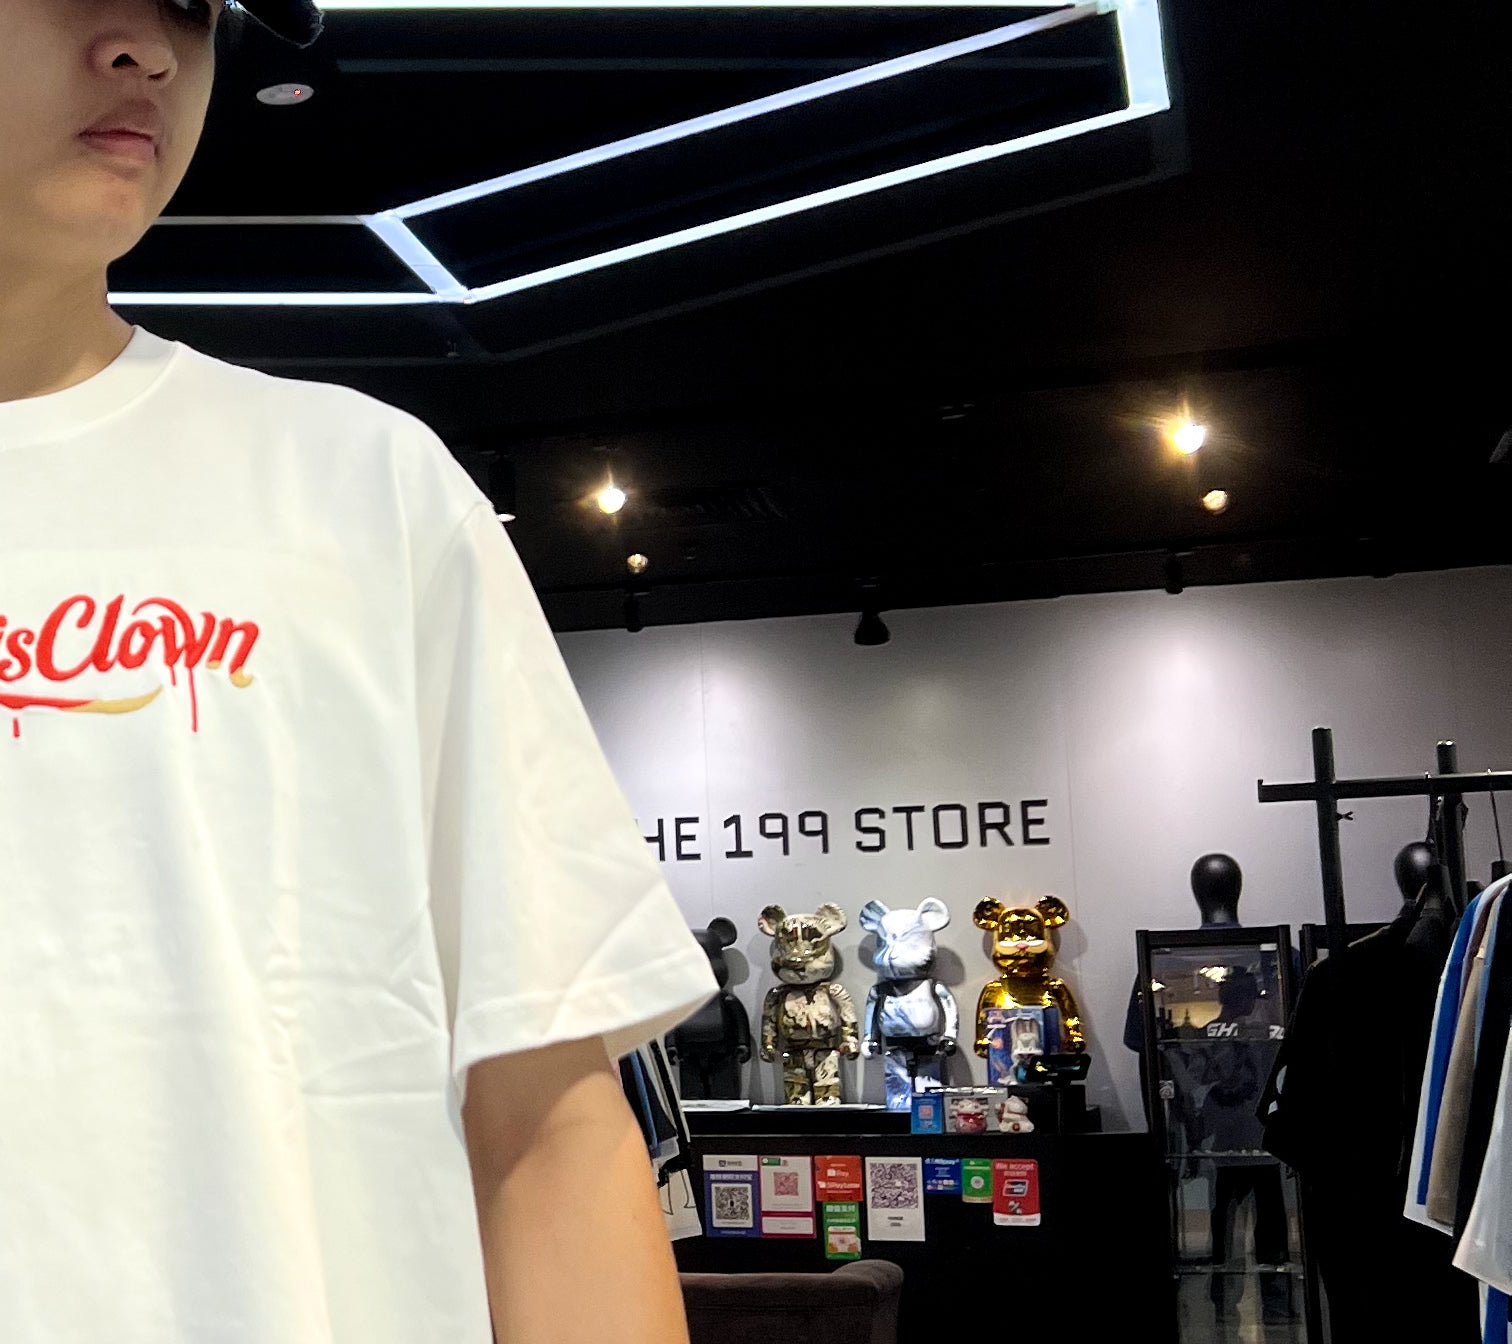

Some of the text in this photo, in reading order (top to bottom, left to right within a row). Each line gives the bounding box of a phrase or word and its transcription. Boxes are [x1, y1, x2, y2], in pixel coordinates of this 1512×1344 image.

[634, 798, 1051, 861] HE 199 STORE
